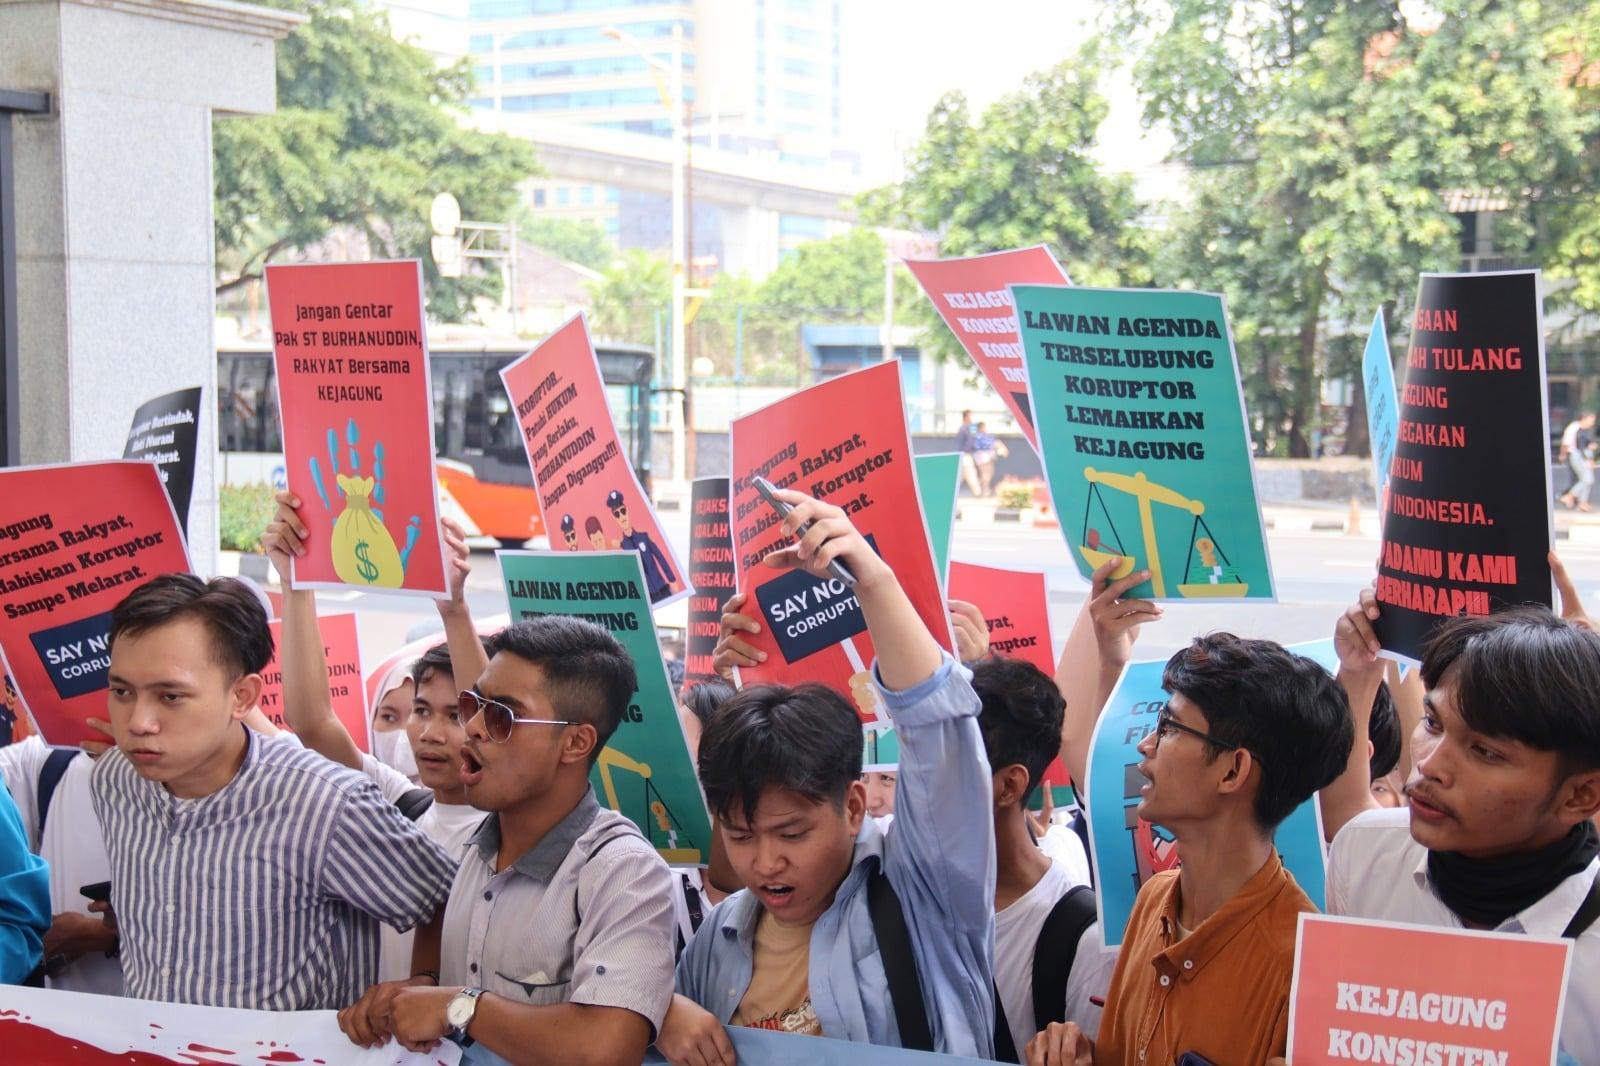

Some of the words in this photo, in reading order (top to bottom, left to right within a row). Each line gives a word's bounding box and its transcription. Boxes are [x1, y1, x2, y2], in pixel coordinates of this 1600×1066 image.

[296, 305, 341, 322] Jangan
[345, 304, 393, 320] Gentar
[1024, 310, 1111, 335] LAWAN
[1117, 317, 1222, 340] AGENDA
[275, 331, 298, 347] Pak
[303, 332, 318, 347] ST
[323, 330, 423, 350] BURHANUDDIN,
[293, 358, 344, 374] RAKYAT
[348, 360, 411, 374] Bersama
[1041, 341, 1215, 370] TERSELUBUNG
[1432, 347, 1522, 371] TULANG
[318, 385, 383, 402] KEJAGUNG
[545, 381, 578, 421] HUKUM
[1064, 374, 1197, 401] KORUPTOR
[1065, 404, 1206, 431] LEMAHKAN
[532, 442, 549, 468] yang
[537, 426, 597, 488] BURHANUDDIN
[800, 433, 867, 478] Rakyat,
[1073, 435, 1206, 461] KEJAGUNG
[543, 482, 568, 511] Jangan
[566, 439, 619, 486] Diganggu!!!
[810, 449, 893, 500] Koruptor
[1392, 496, 1494, 526] INDONESIA.
[0, 540, 60, 568] ersama
[59, 514, 134, 548] Rakyat,
[77, 531, 164, 570] Koruptor
[1447, 551, 1518, 585] KAMI
[3, 593, 66, 620] Sampe
[66, 564, 148, 601] Melarat.
[509, 579, 562, 600] LAWAN
[566, 581, 641, 600] AGENDA
[770, 589, 808, 623] SAY
[812, 577, 846, 604] NO
[46, 640, 83, 666] SAY
[1335, 981, 1508, 1031] KEJAGUNG
